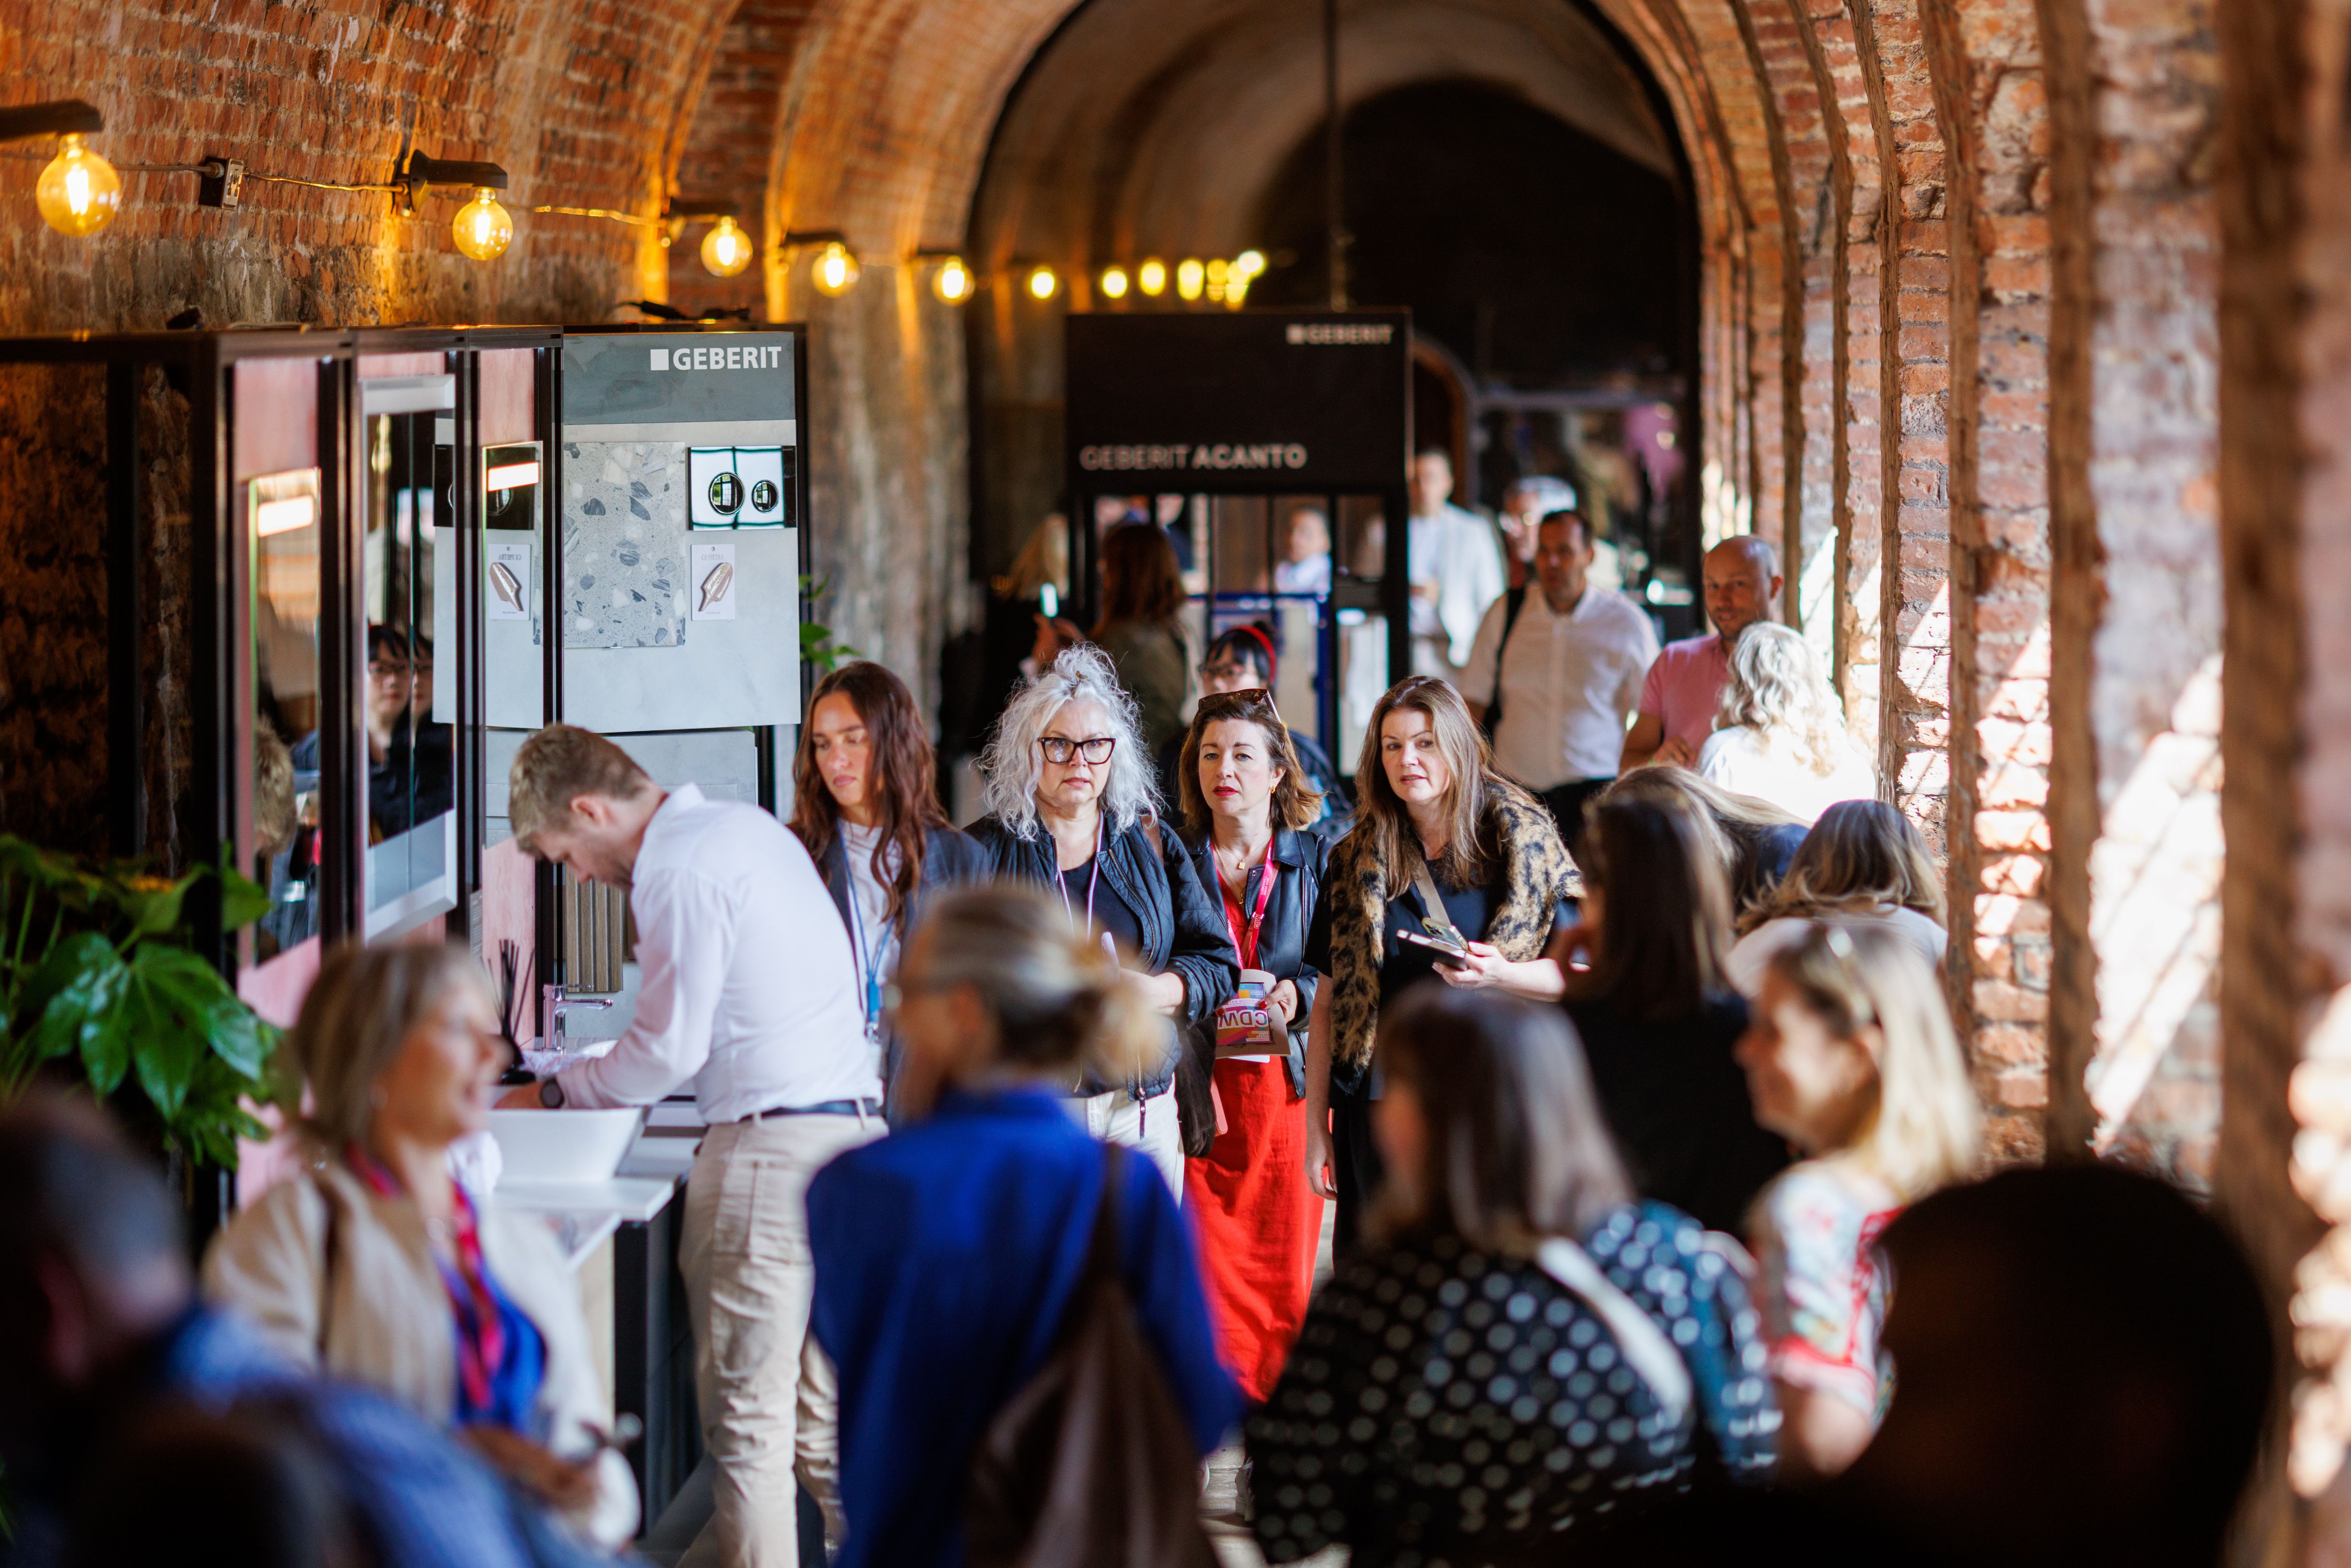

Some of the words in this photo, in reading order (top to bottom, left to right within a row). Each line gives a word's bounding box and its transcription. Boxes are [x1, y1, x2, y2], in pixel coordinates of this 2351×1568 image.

[1307, 324, 1393, 344] GEBERIT
[673, 347, 781, 370] GEBERIT
[1080, 444, 1189, 470] GEBERIT
[1192, 444, 1308, 469] ACANTO
[1218, 1010, 1268, 1029] CDW
